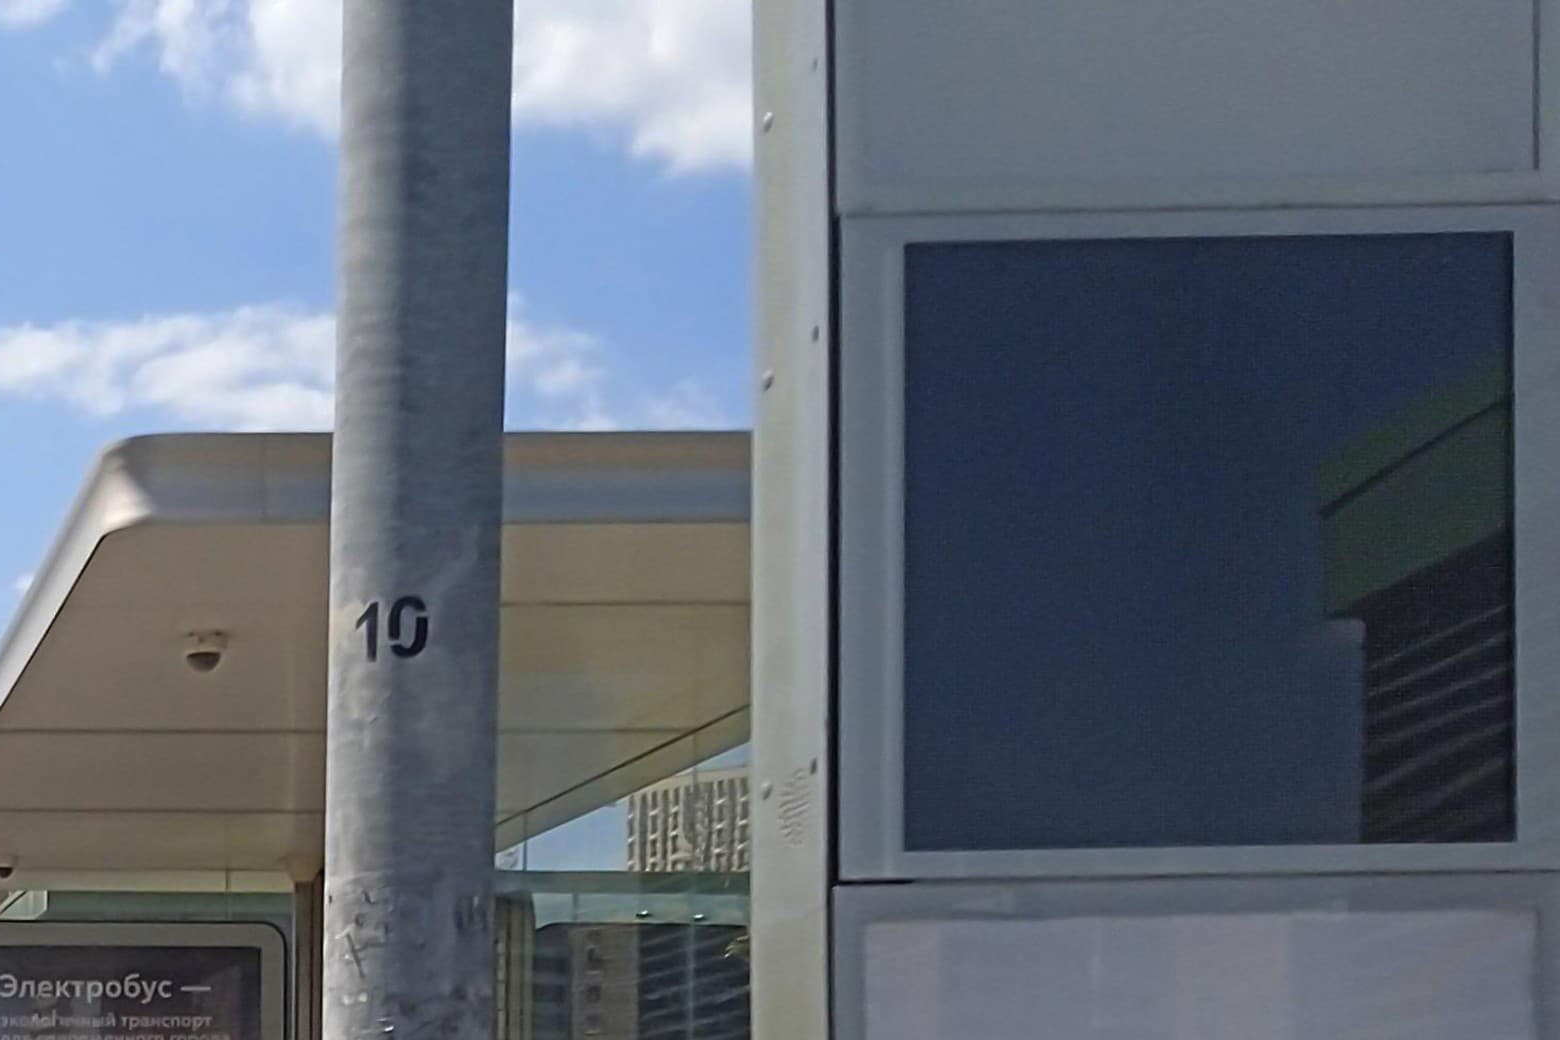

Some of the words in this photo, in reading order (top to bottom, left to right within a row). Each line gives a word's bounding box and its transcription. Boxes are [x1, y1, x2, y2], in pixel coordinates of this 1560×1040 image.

[355, 596, 428, 662] 10
[0, 973, 173, 1004] Электробус
[120, 1015, 213, 1032] транспорт
